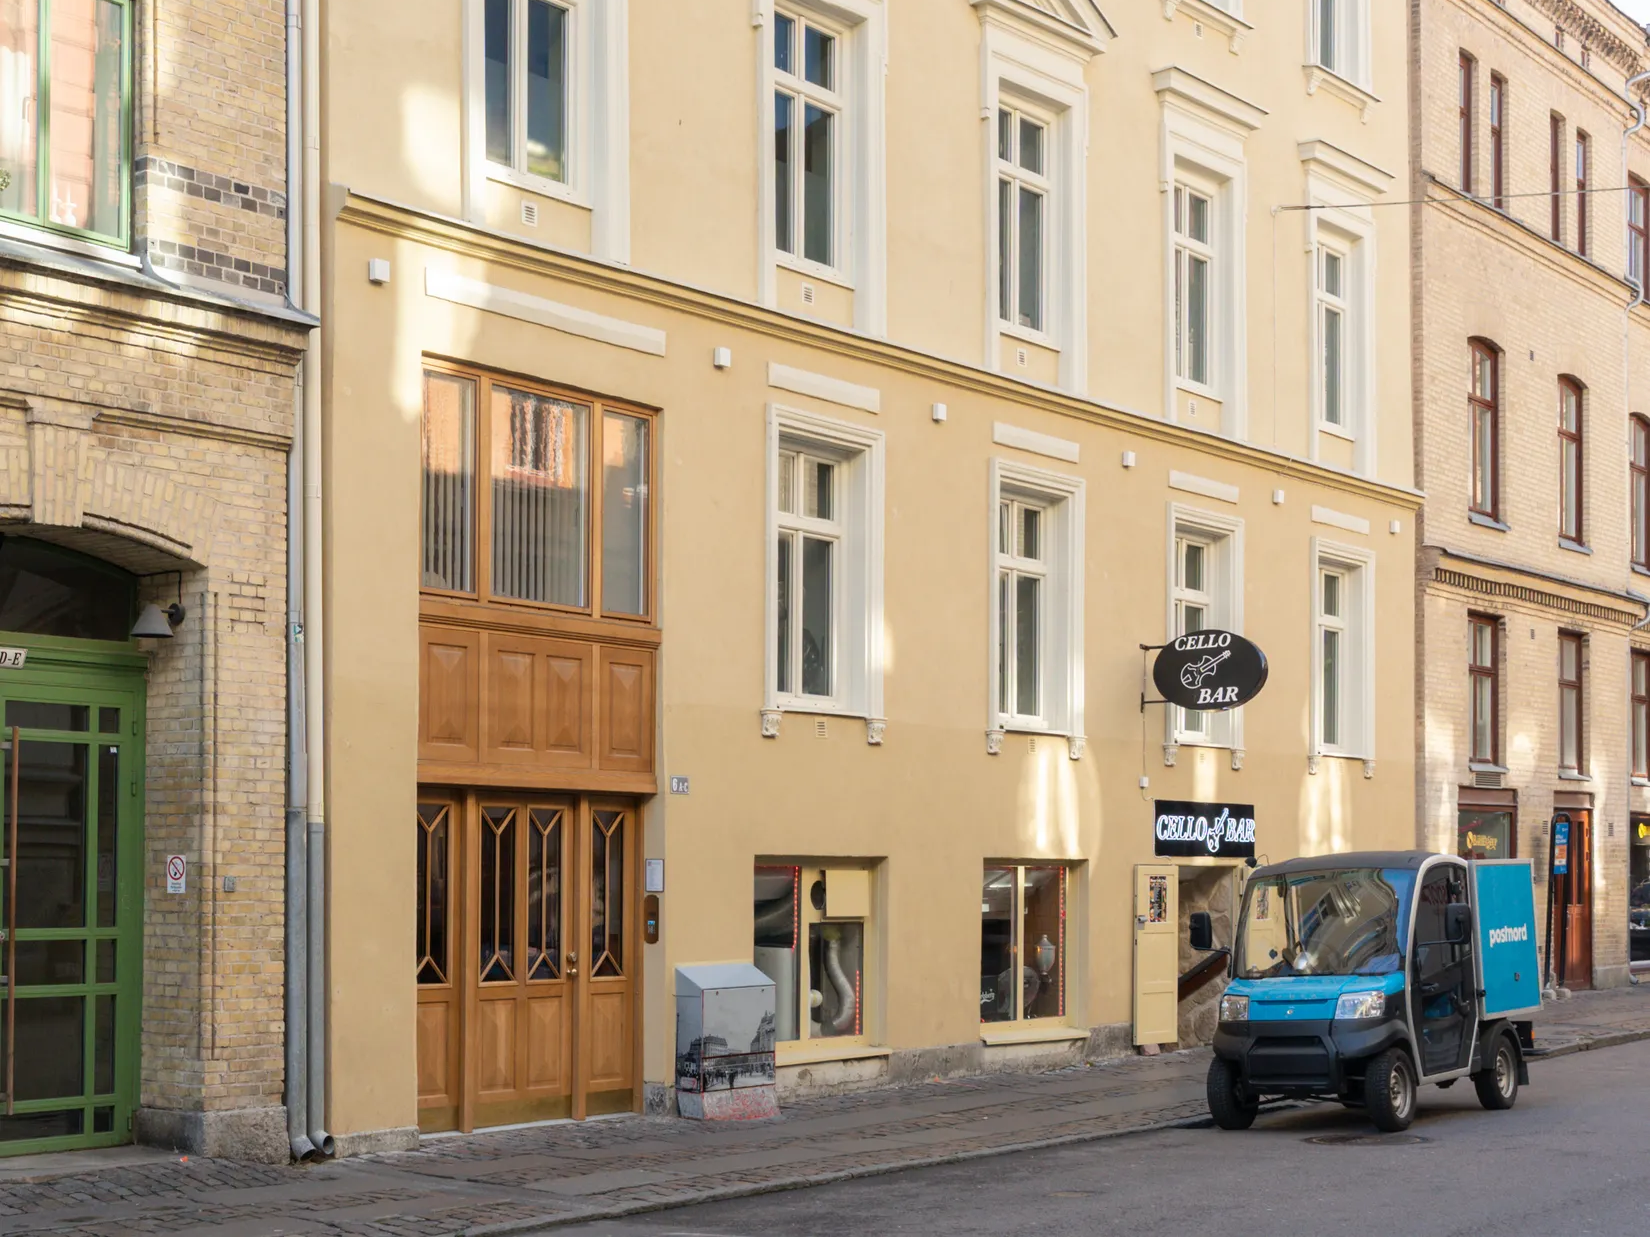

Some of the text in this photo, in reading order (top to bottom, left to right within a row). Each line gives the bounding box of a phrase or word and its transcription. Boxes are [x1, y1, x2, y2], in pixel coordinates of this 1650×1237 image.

[1174, 633, 1232, 651] CELLO
[0, 651, 22, 666] D-E
[1196, 686, 1239, 704] BAR
[672, 778, 678, 792] 6
[1156, 814, 1256, 843] CELLO BAR
[1489, 923, 1528, 948] postnord
